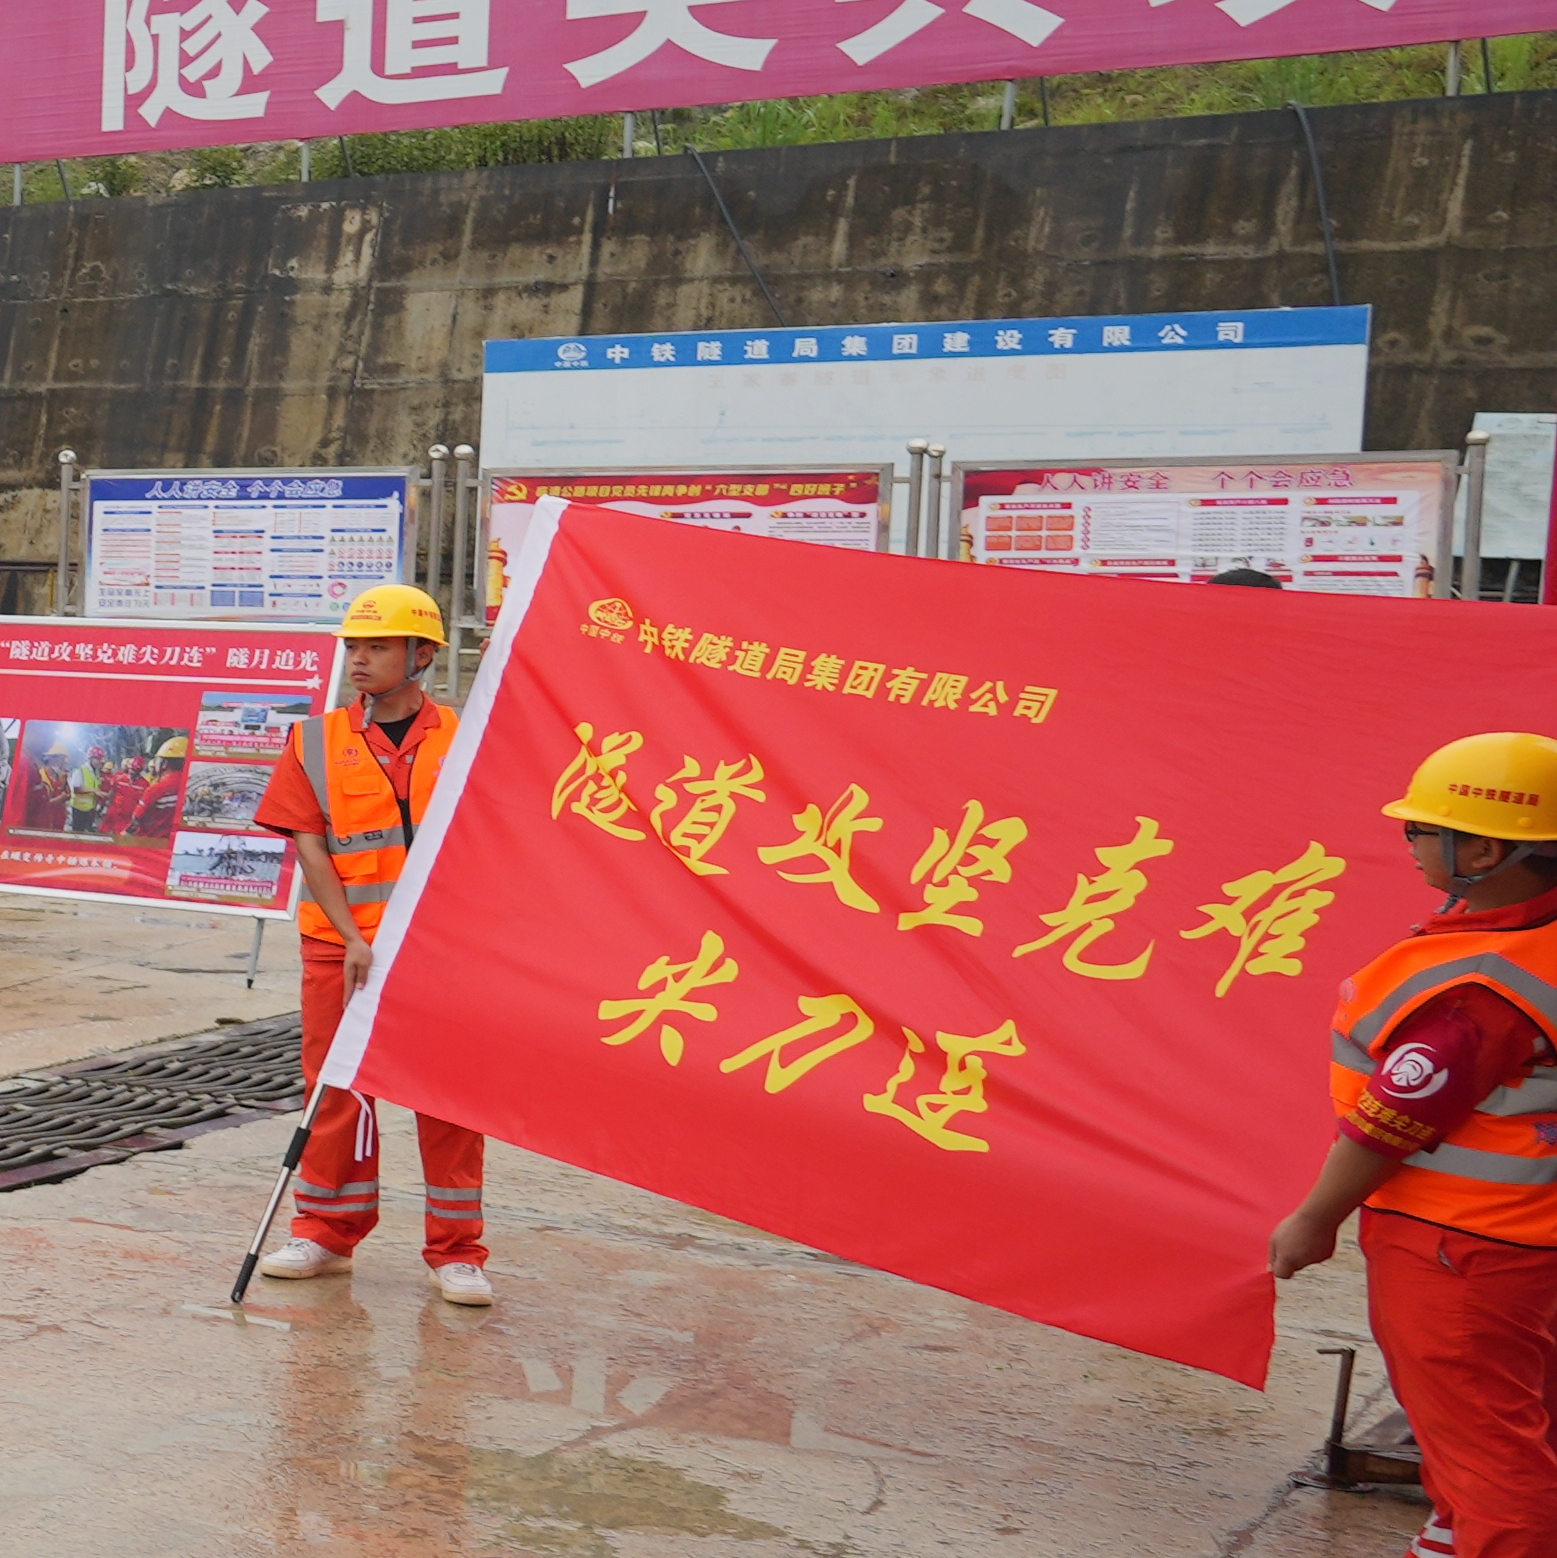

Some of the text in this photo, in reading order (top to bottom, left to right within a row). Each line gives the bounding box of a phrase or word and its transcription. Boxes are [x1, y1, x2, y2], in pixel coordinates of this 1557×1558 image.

[606, 322, 1246, 364] 中铁隧道局集团建设有限公司
[1039, 467, 1356, 492] 人人讲安全 个个会应急
[0, 640, 320, 672] “隧道攻坚克难尖刀连” 隧月追光
[638, 619, 1058, 724] 中铁隧道局集团有限公司
[1447, 783, 1540, 807] 中国中铁隧道局
[551, 722, 1347, 998] 隧道攻坚克难
[598, 930, 1027, 1153] 尖刀连
